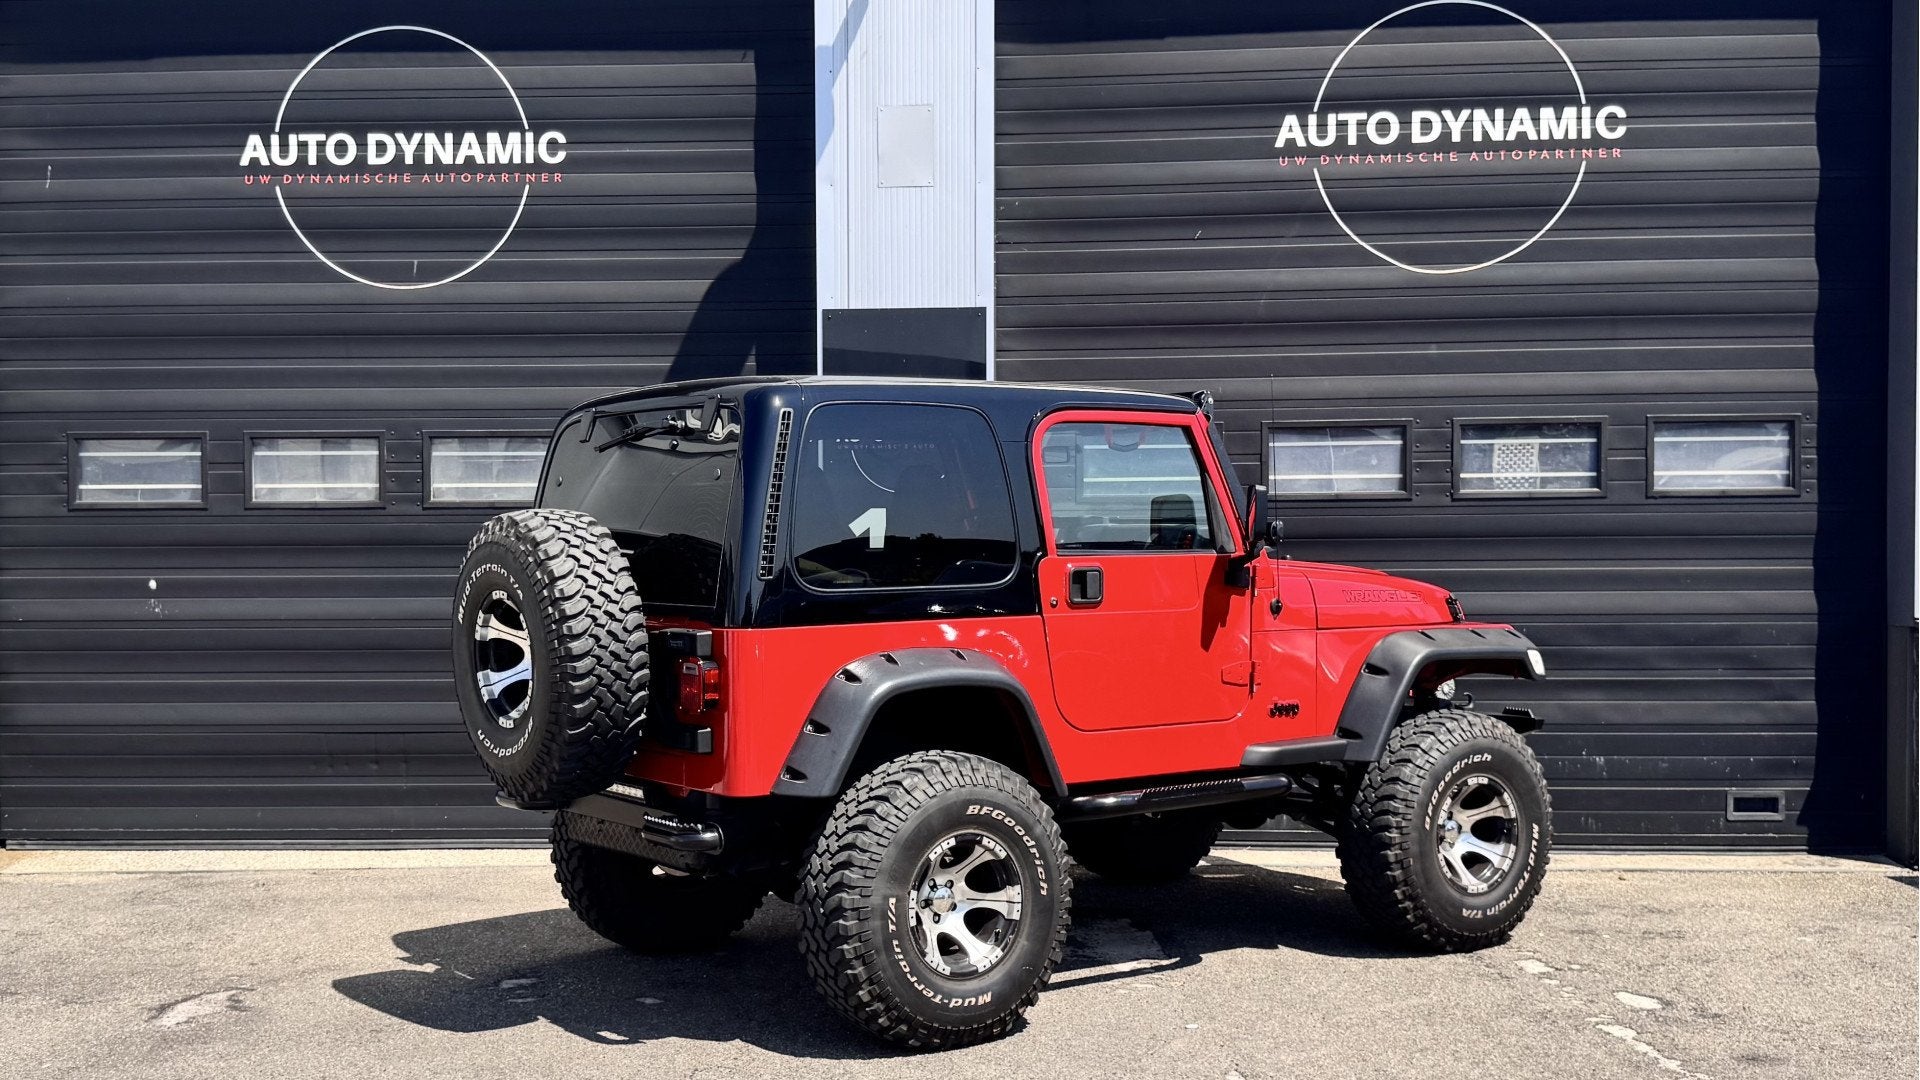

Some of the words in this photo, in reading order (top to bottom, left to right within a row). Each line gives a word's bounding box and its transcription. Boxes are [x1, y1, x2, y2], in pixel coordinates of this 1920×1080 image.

[1274, 111, 1400, 147] AUTO
[1411, 105, 1627, 144] DYNAMIC
[239, 133, 357, 167] AUTO
[367, 131, 567, 165] DYNAMIC
[1279, 155, 1307, 167] UW
[1320, 151, 1458, 165] DYNAMISCHE
[1469, 147, 1623, 162] AUTOPARTNER
[244, 174, 272, 185] UW
[283, 173, 412, 184] DYNAMISCHE
[422, 172, 563, 184] AUTOPARTNER
[848, 508, 887, 549] 1
[458, 563, 508, 624] Mud-Terrain
[1269, 702, 1300, 719] Jeep
[477, 716, 534, 758] BFGoodrich
[1424, 752, 1492, 830] BFGoodrich
[966, 804, 1048, 896] BFGoodrich
[1487, 823, 1540, 916] Mud-Terrain
[887, 897, 897, 933] T/A
[1461, 907, 1484, 919] T/A
[892, 939, 992, 1008] Mud-Terrain
